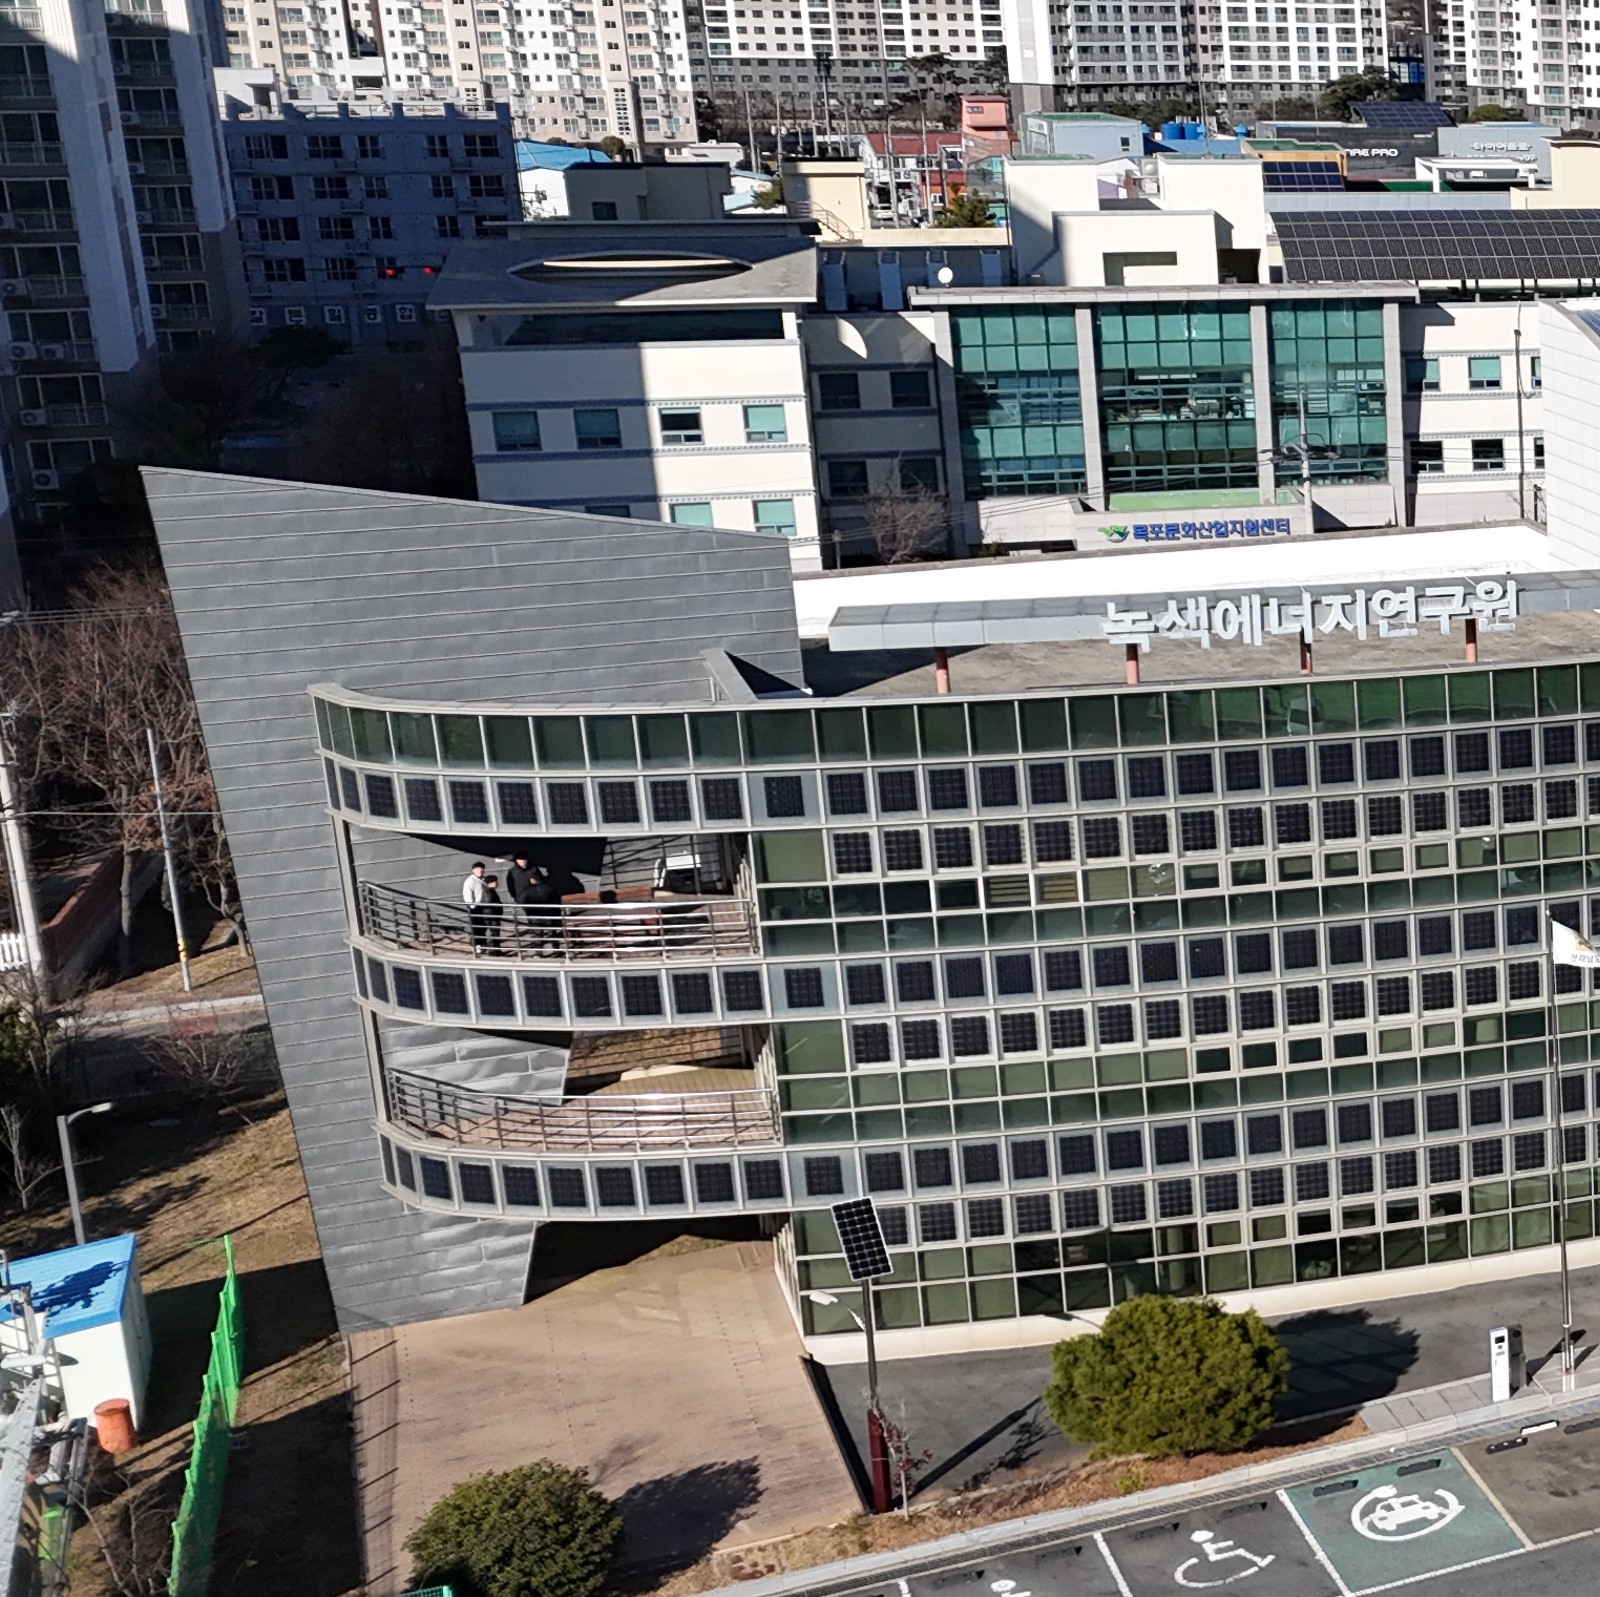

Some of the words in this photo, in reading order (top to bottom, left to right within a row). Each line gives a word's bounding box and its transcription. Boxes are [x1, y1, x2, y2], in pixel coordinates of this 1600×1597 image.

[1371, 148, 1399, 157] PRO
[1132, 518, 1291, 542] 목포문화산업지원센터
[1103, 580, 1518, 653] 녹색에너지연구원
